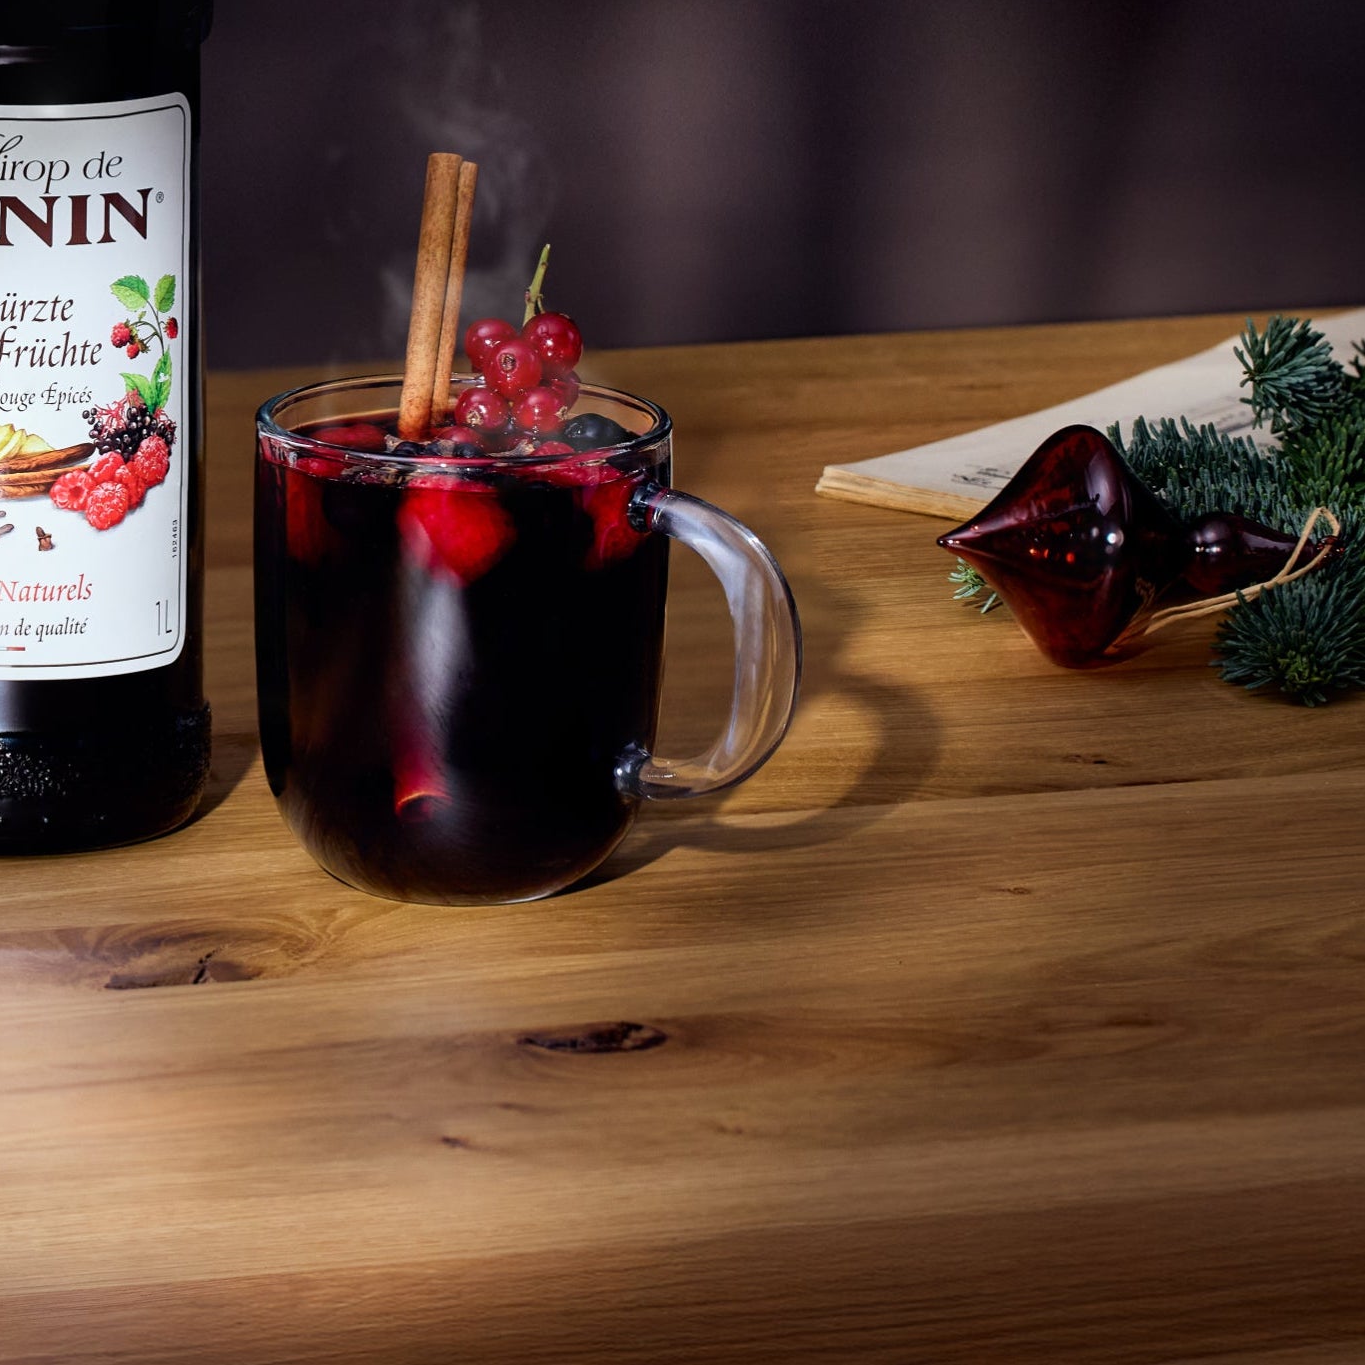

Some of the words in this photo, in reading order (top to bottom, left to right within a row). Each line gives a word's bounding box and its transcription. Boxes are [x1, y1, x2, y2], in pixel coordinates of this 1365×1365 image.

[82, 151, 123, 179] de
[14, 618, 32, 636] de
[35, 617, 89, 642] qualité
